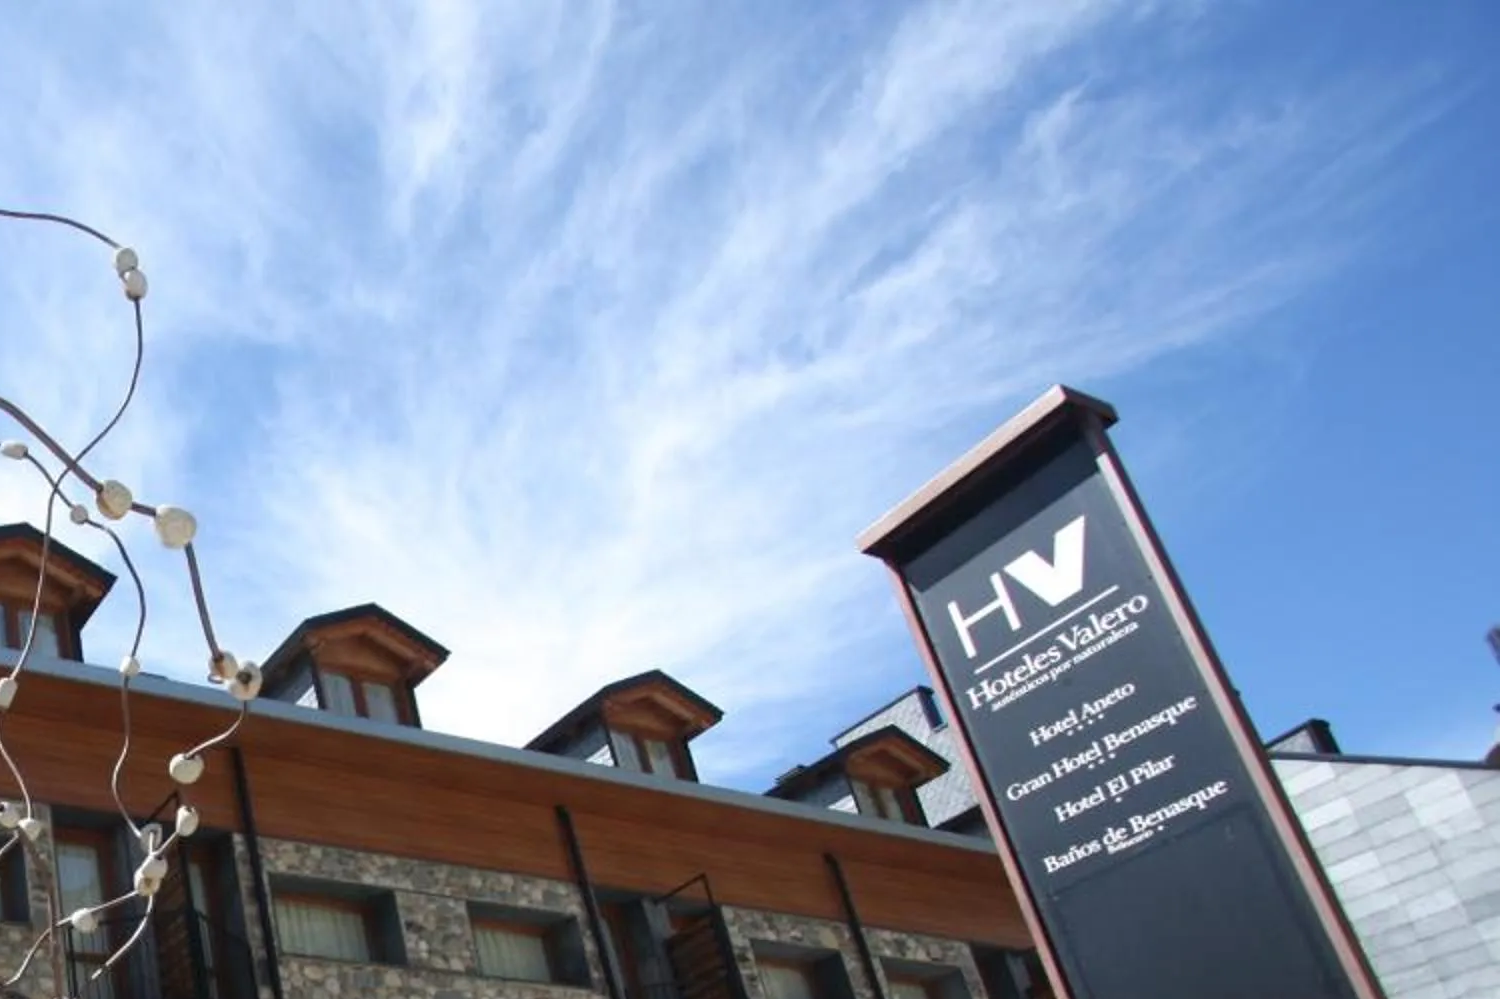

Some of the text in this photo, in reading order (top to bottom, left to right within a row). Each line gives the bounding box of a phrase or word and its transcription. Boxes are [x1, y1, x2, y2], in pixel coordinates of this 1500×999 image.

[947, 515, 1086, 659] HV
[965, 595, 1149, 710] Hoteles Valero
[1006, 696, 1197, 801] Gran Hotel Benasque
[1029, 683, 1136, 747] Hotel Aneto
[1043, 837, 1101, 874] Baños
[1102, 827, 1128, 846] de
[1128, 780, 1229, 834] Benasque
[1054, 754, 1176, 824] Hotel El Pilar
